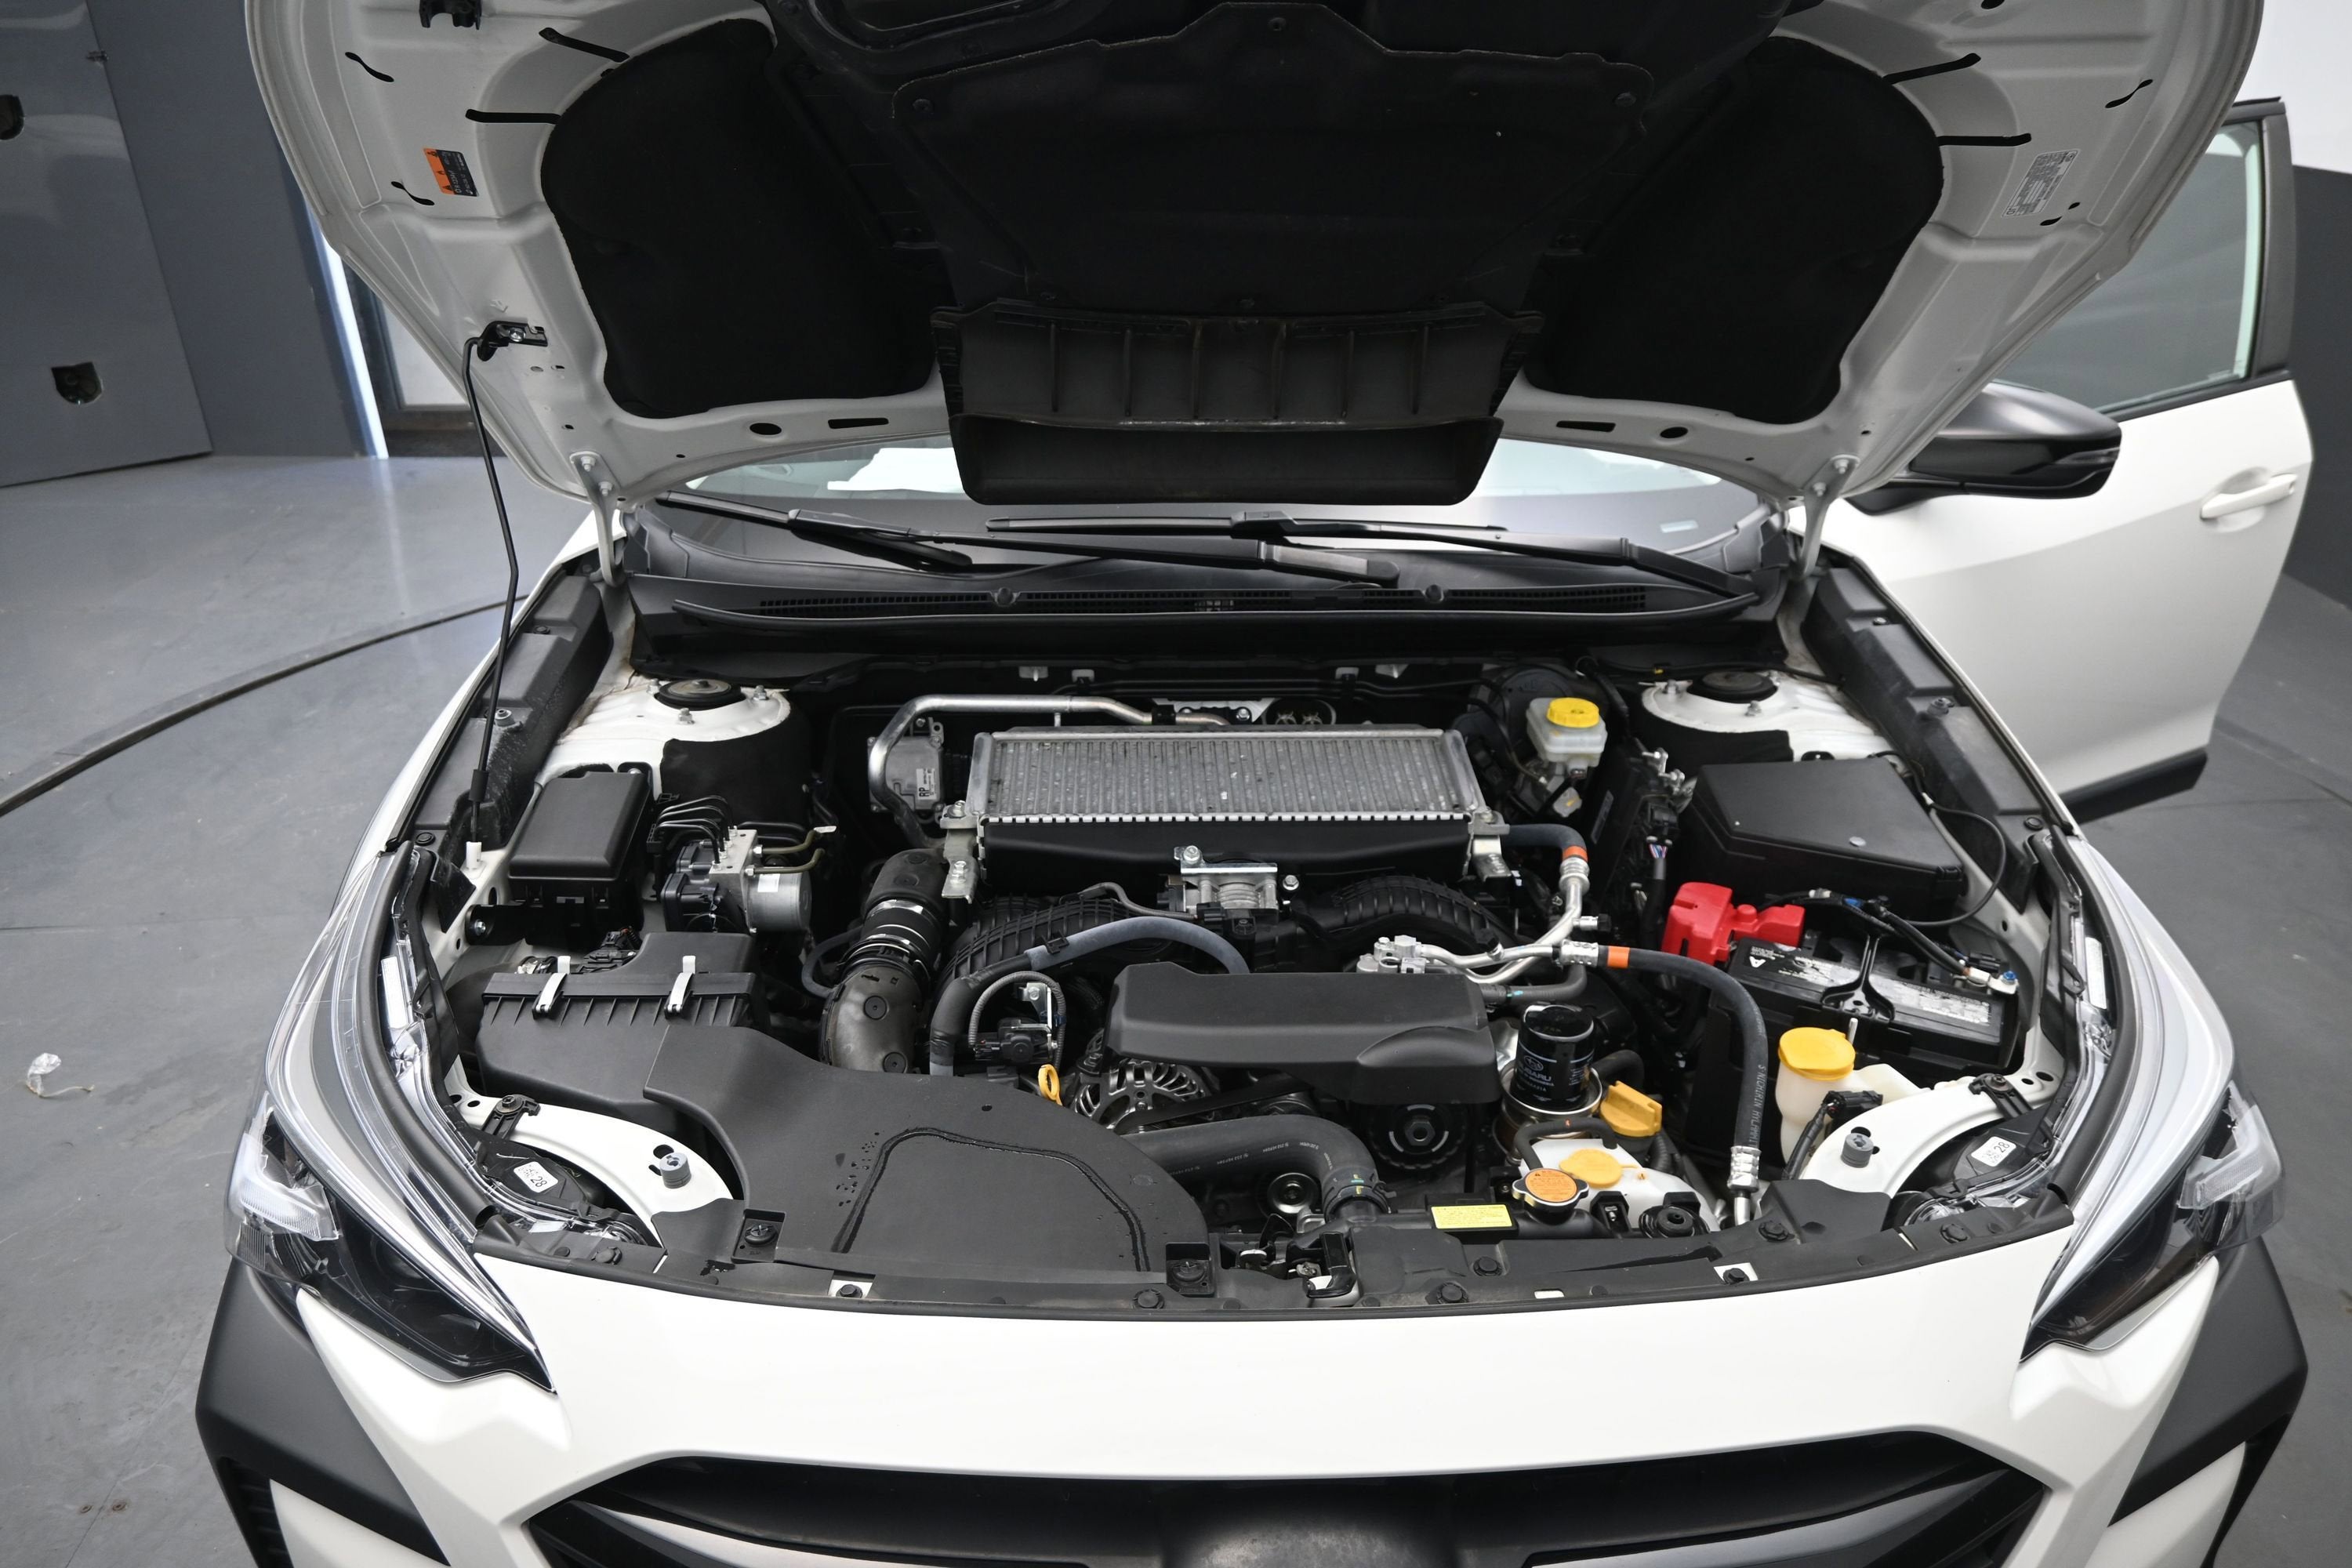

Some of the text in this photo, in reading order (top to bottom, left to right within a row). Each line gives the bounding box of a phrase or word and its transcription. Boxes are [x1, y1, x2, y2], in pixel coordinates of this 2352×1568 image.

[919, 787, 930, 797] RP
[1994, 1142, 2010, 1153] 28
[530, 1176, 548, 1188] 28
